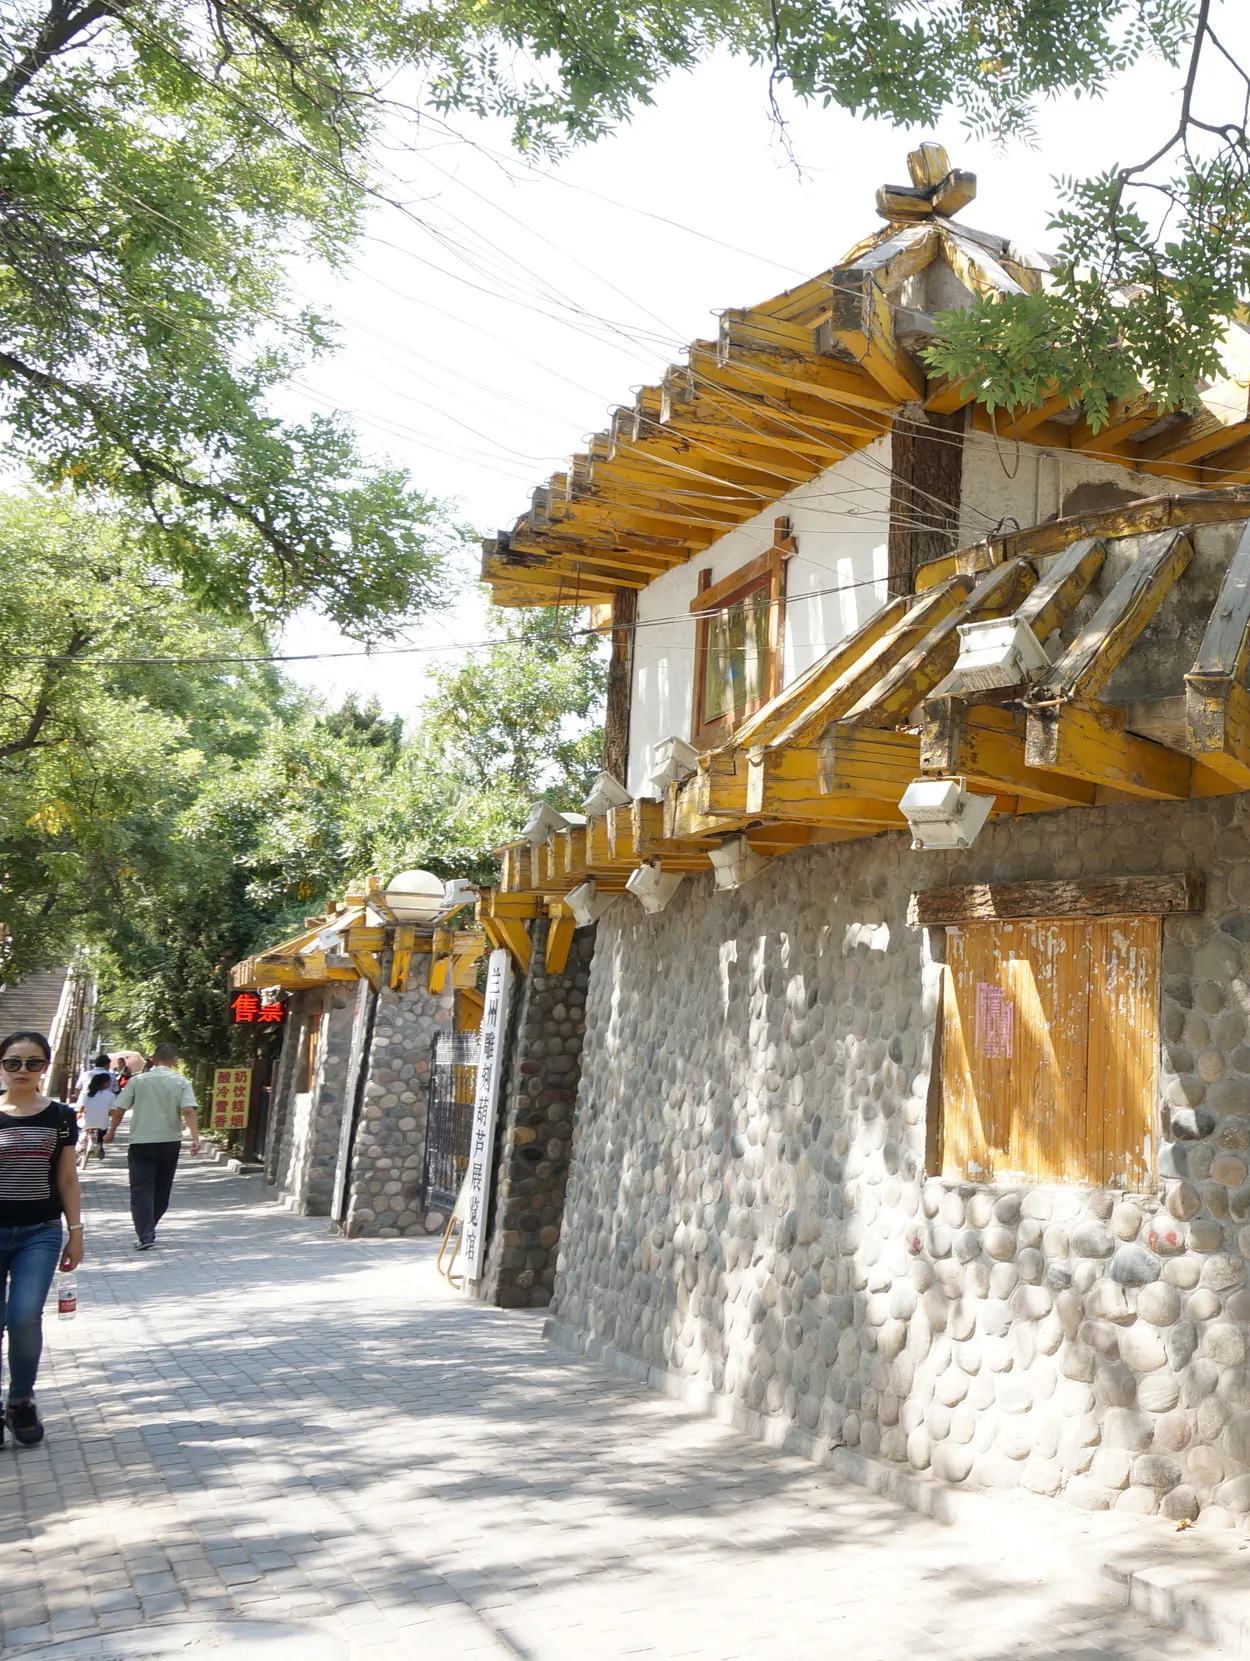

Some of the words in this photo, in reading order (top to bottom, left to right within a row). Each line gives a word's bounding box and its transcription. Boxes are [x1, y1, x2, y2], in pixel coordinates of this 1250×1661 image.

[217, 1071, 247, 1084] 酸奶
[216, 1085, 246, 1098] 冷饮
[215, 1100, 245, 1113] 雪糕
[214, 1114, 244, 1128] 香烟
